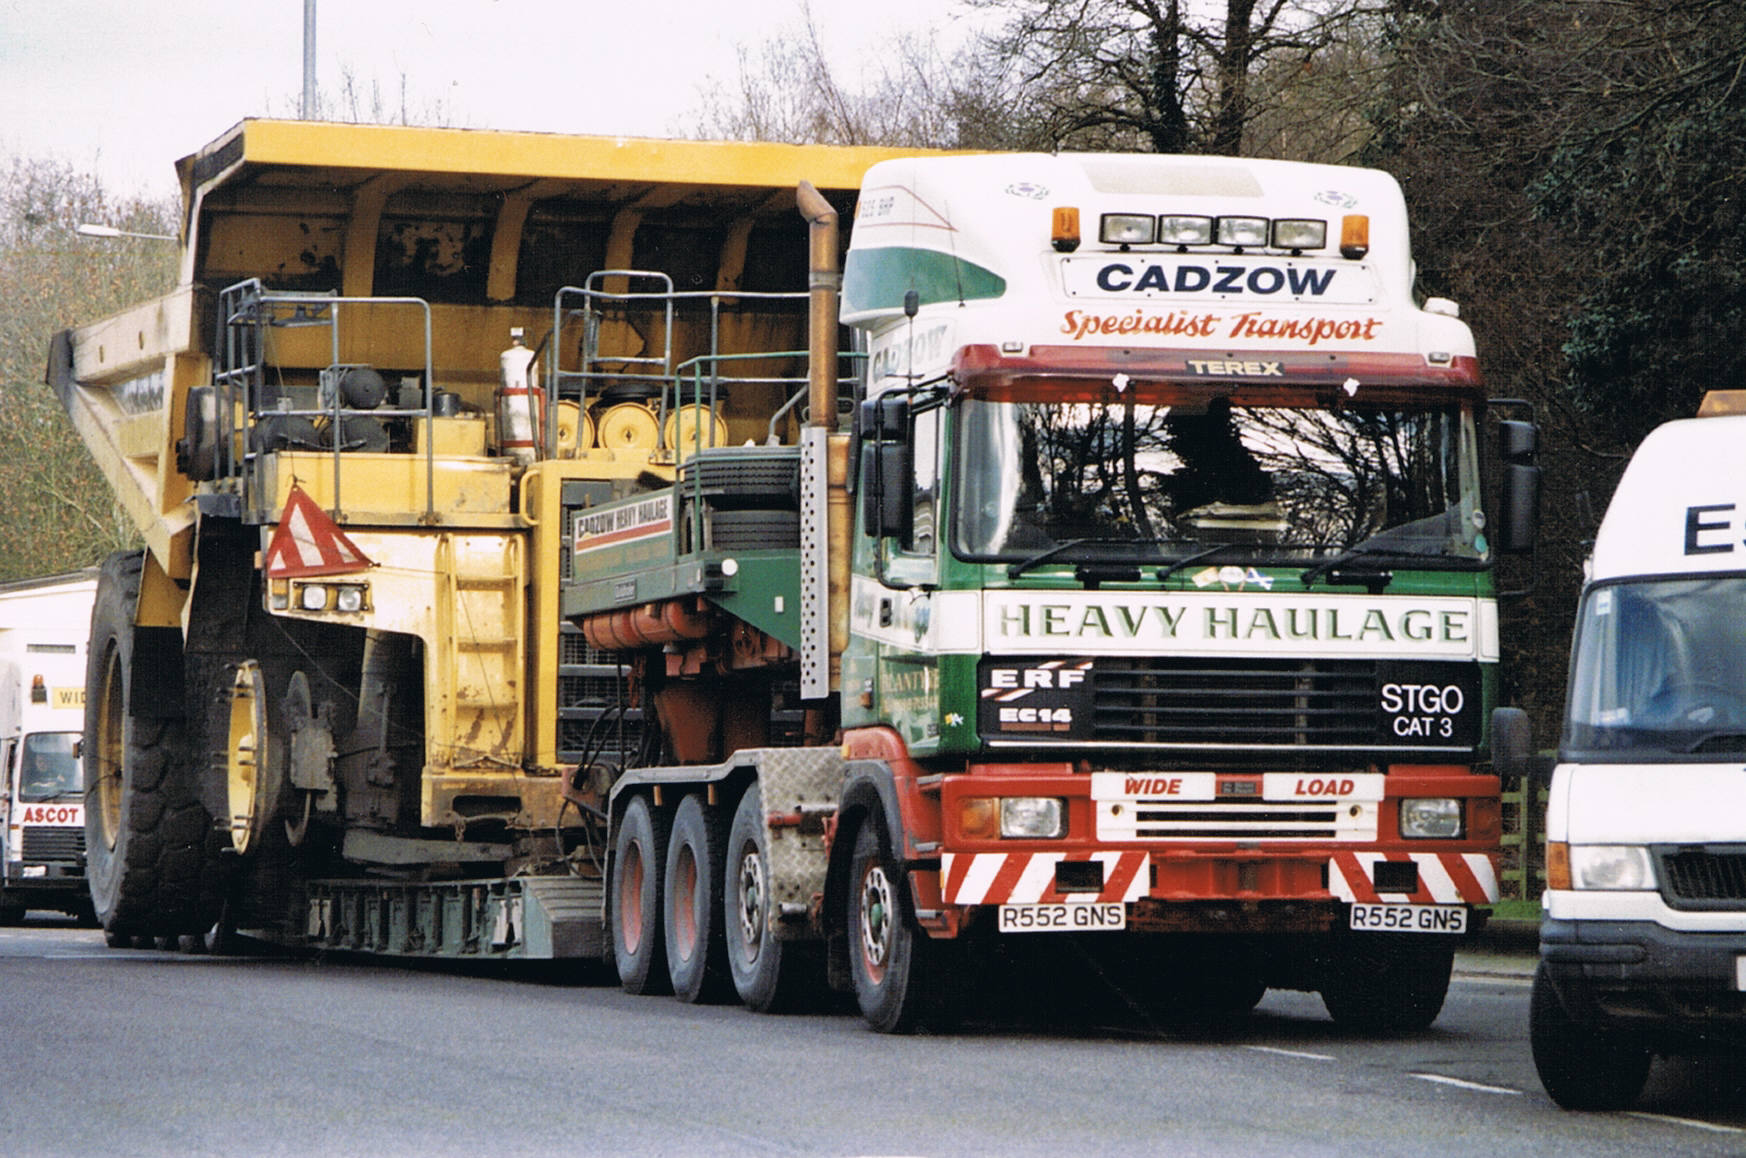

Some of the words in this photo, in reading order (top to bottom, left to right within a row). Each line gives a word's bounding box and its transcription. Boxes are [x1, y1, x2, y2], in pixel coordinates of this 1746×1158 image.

[1096, 262, 1337, 296] CADZOW
[1061, 310, 1221, 340] Specialist
[1229, 311, 1384, 345] Transport
[1188, 358, 1284, 377] TEREX
[616, 505, 637, 530] HEAVY
[638, 498, 668, 524] HAULAGE
[1684, 503, 1746, 556] E
[1002, 604, 1188, 638] HEAVY
[1203, 607, 1469, 641] HAULAGE
[991, 669, 1085, 688] ERF
[1381, 683, 1464, 714] STGO
[999, 707, 1073, 723] EC14
[1393, 716, 1435, 736] CAT
[1439, 717, 1453, 737] 3
[1124, 778, 1182, 796] WIDE
[1295, 779, 1355, 796] LOAD
[23, 807, 78, 823] ASCOT
[1003, 906, 1067, 927] R552
[1074, 905, 1121, 926] GNS
[1353, 906, 1413, 928] R552
[1418, 908, 1462, 930] GNS
